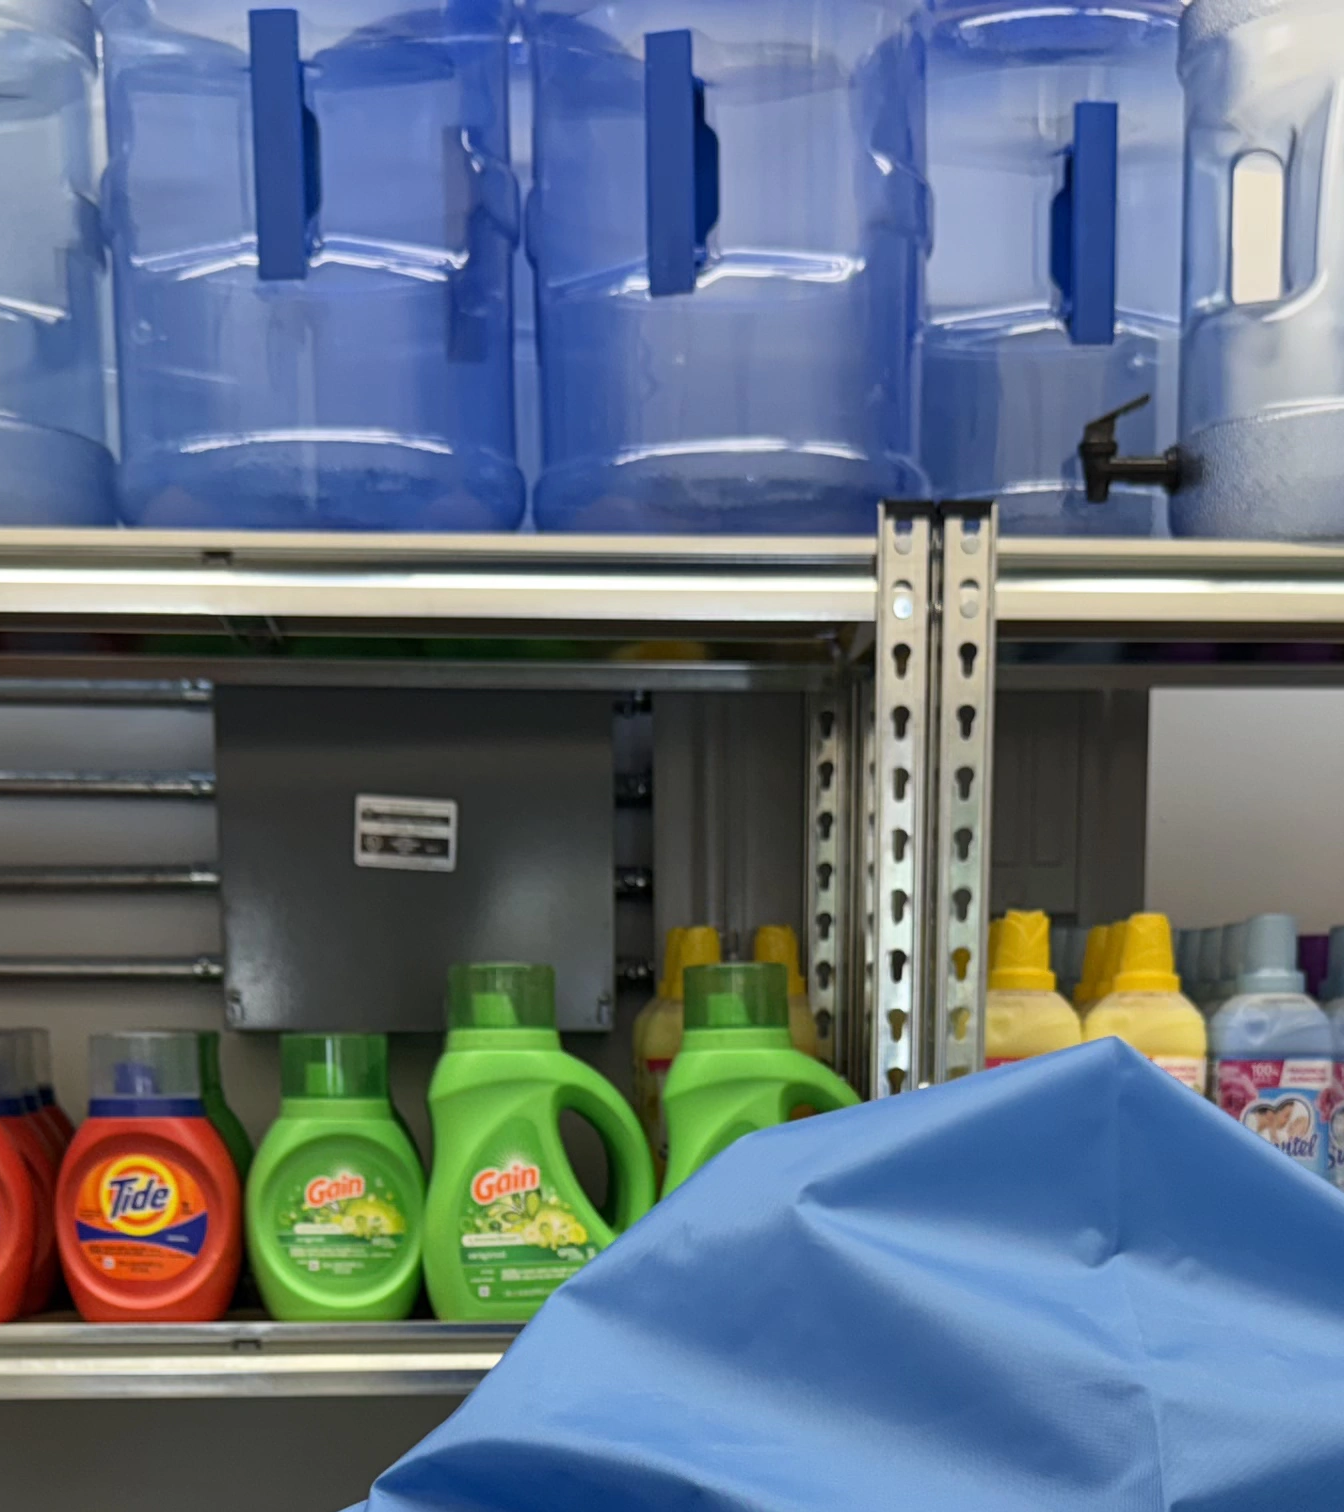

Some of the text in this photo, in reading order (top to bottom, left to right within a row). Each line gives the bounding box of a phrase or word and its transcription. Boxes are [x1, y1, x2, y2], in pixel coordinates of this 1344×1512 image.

[109, 1177, 170, 1219] Tide
[306, 1172, 364, 1207] Gain
[472, 1163, 540, 1205] Gain
